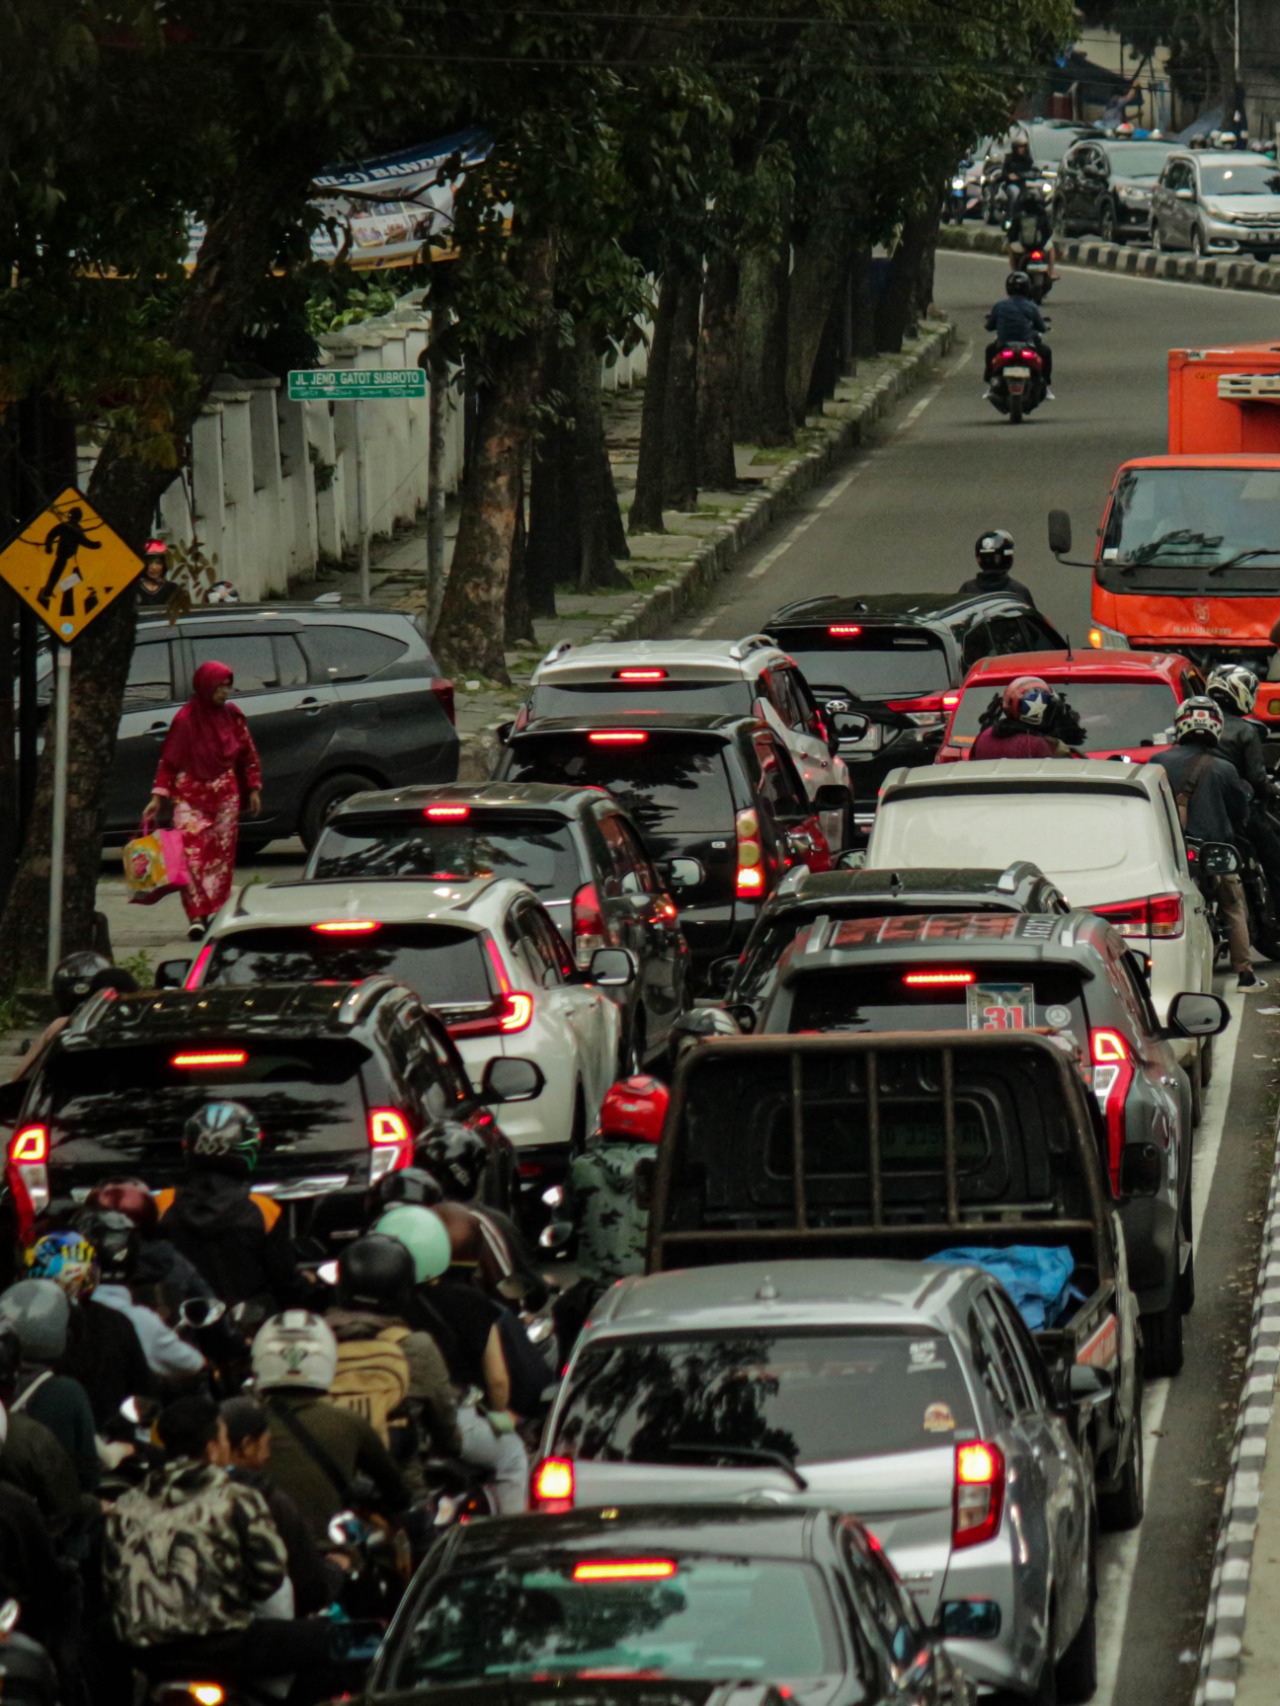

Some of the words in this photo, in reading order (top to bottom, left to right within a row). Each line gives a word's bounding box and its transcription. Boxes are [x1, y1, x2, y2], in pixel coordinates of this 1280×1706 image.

[340, 372, 371, 385] GATOT
[373, 371, 420, 384] SUBROTO
[983, 1006, 1024, 1029] 31
